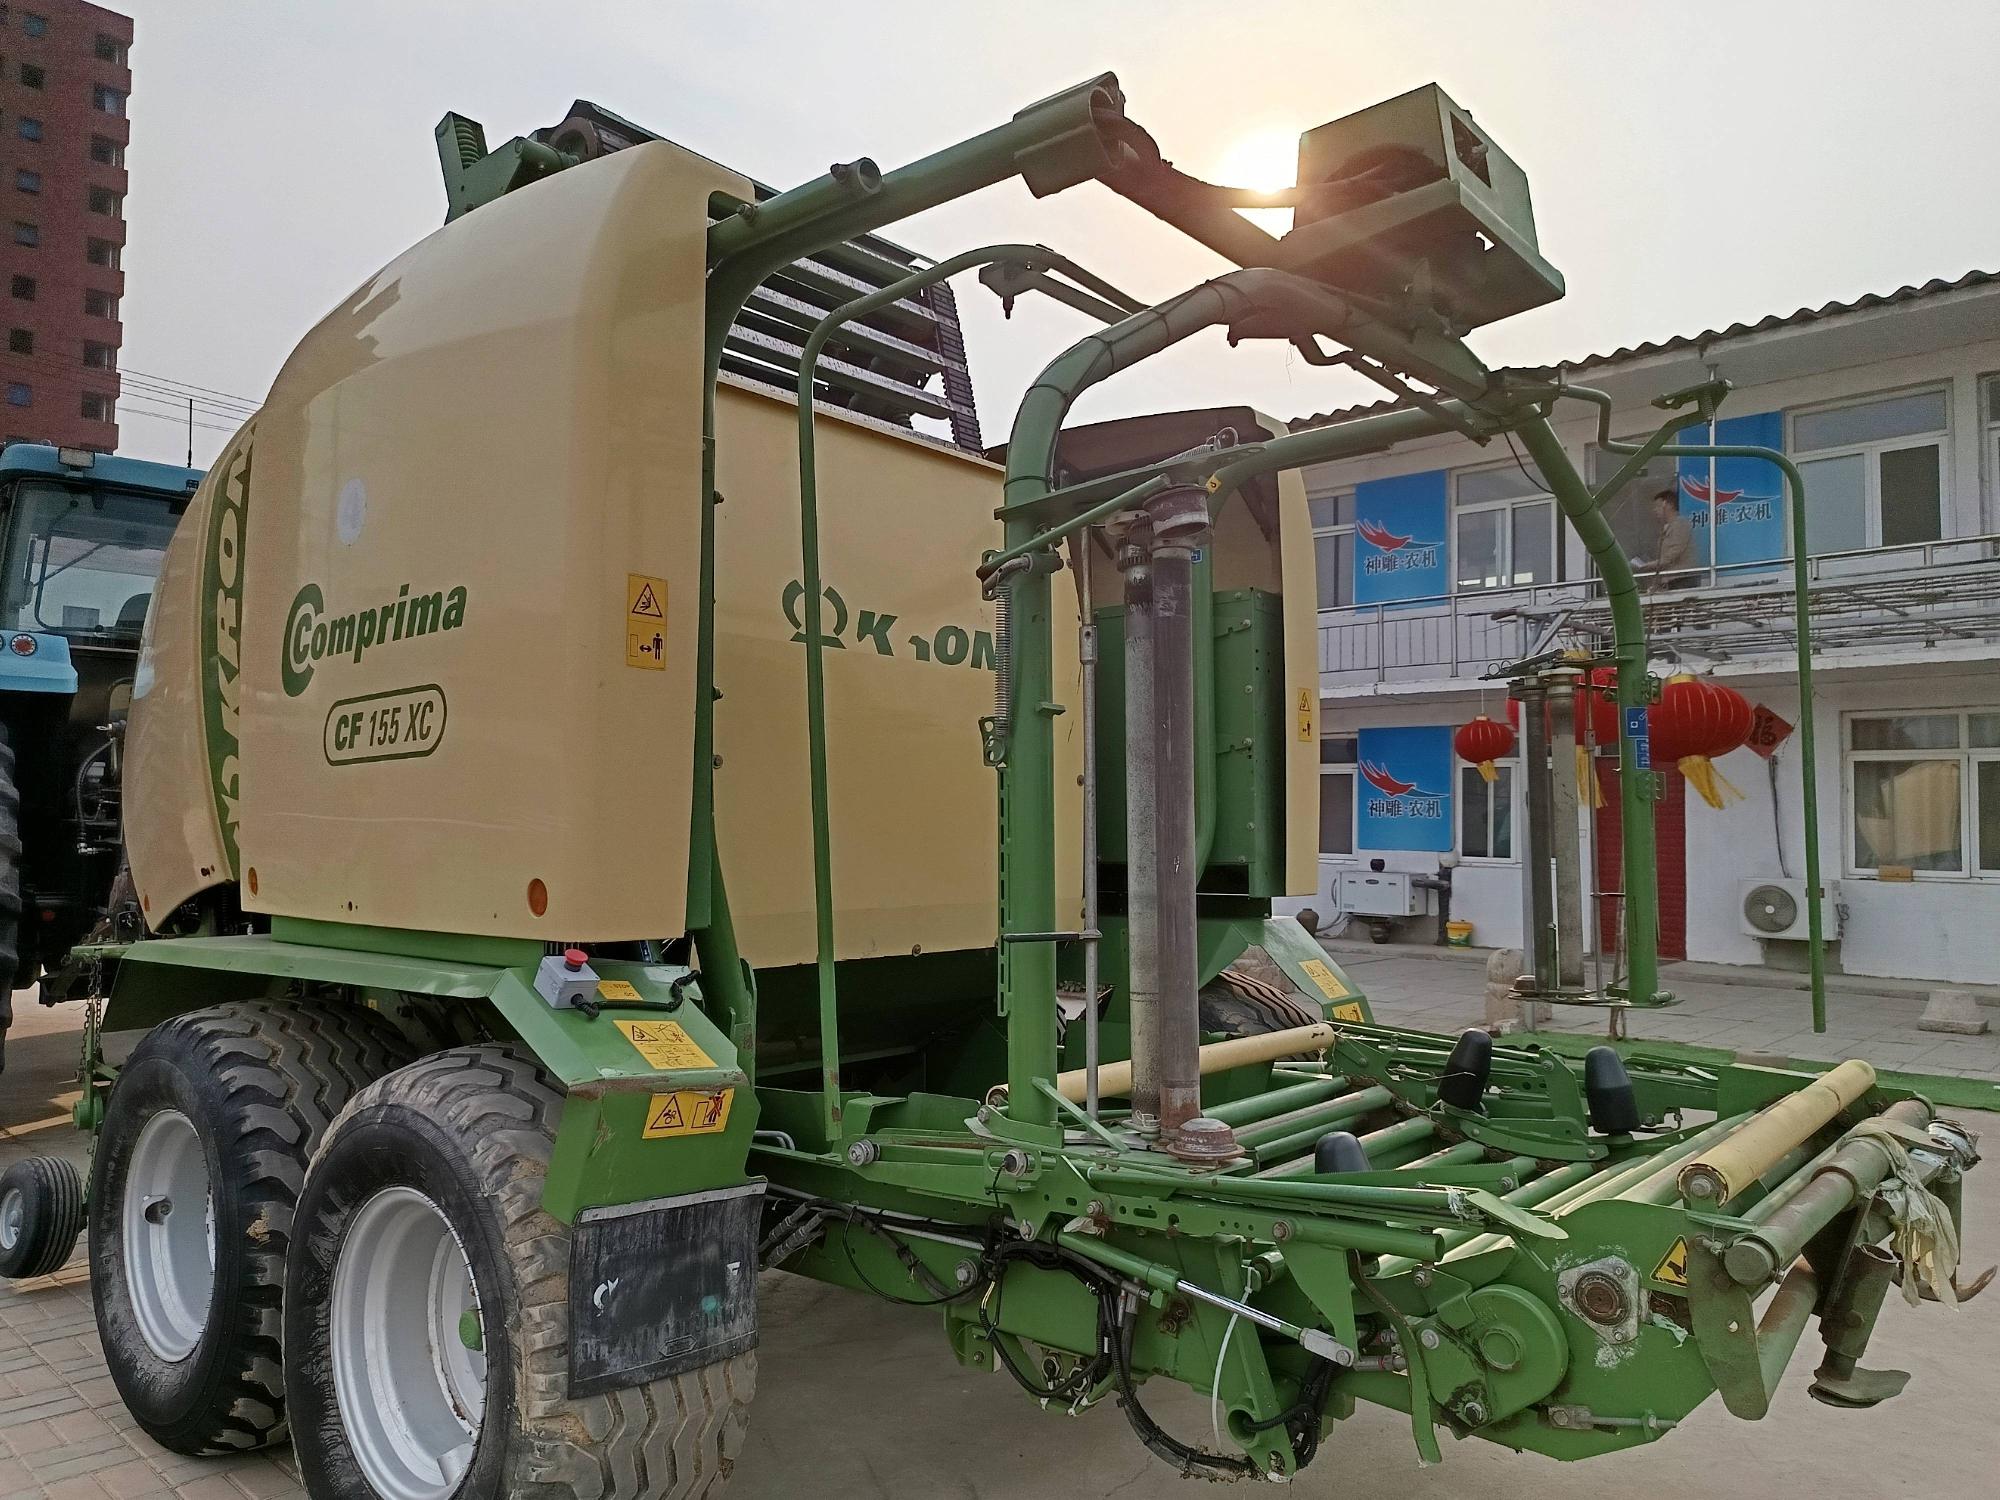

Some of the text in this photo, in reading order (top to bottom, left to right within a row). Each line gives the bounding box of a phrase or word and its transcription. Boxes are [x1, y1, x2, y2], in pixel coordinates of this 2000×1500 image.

[281, 583, 468, 698] Comprima
[334, 700, 434, 751] CF 155 XC
